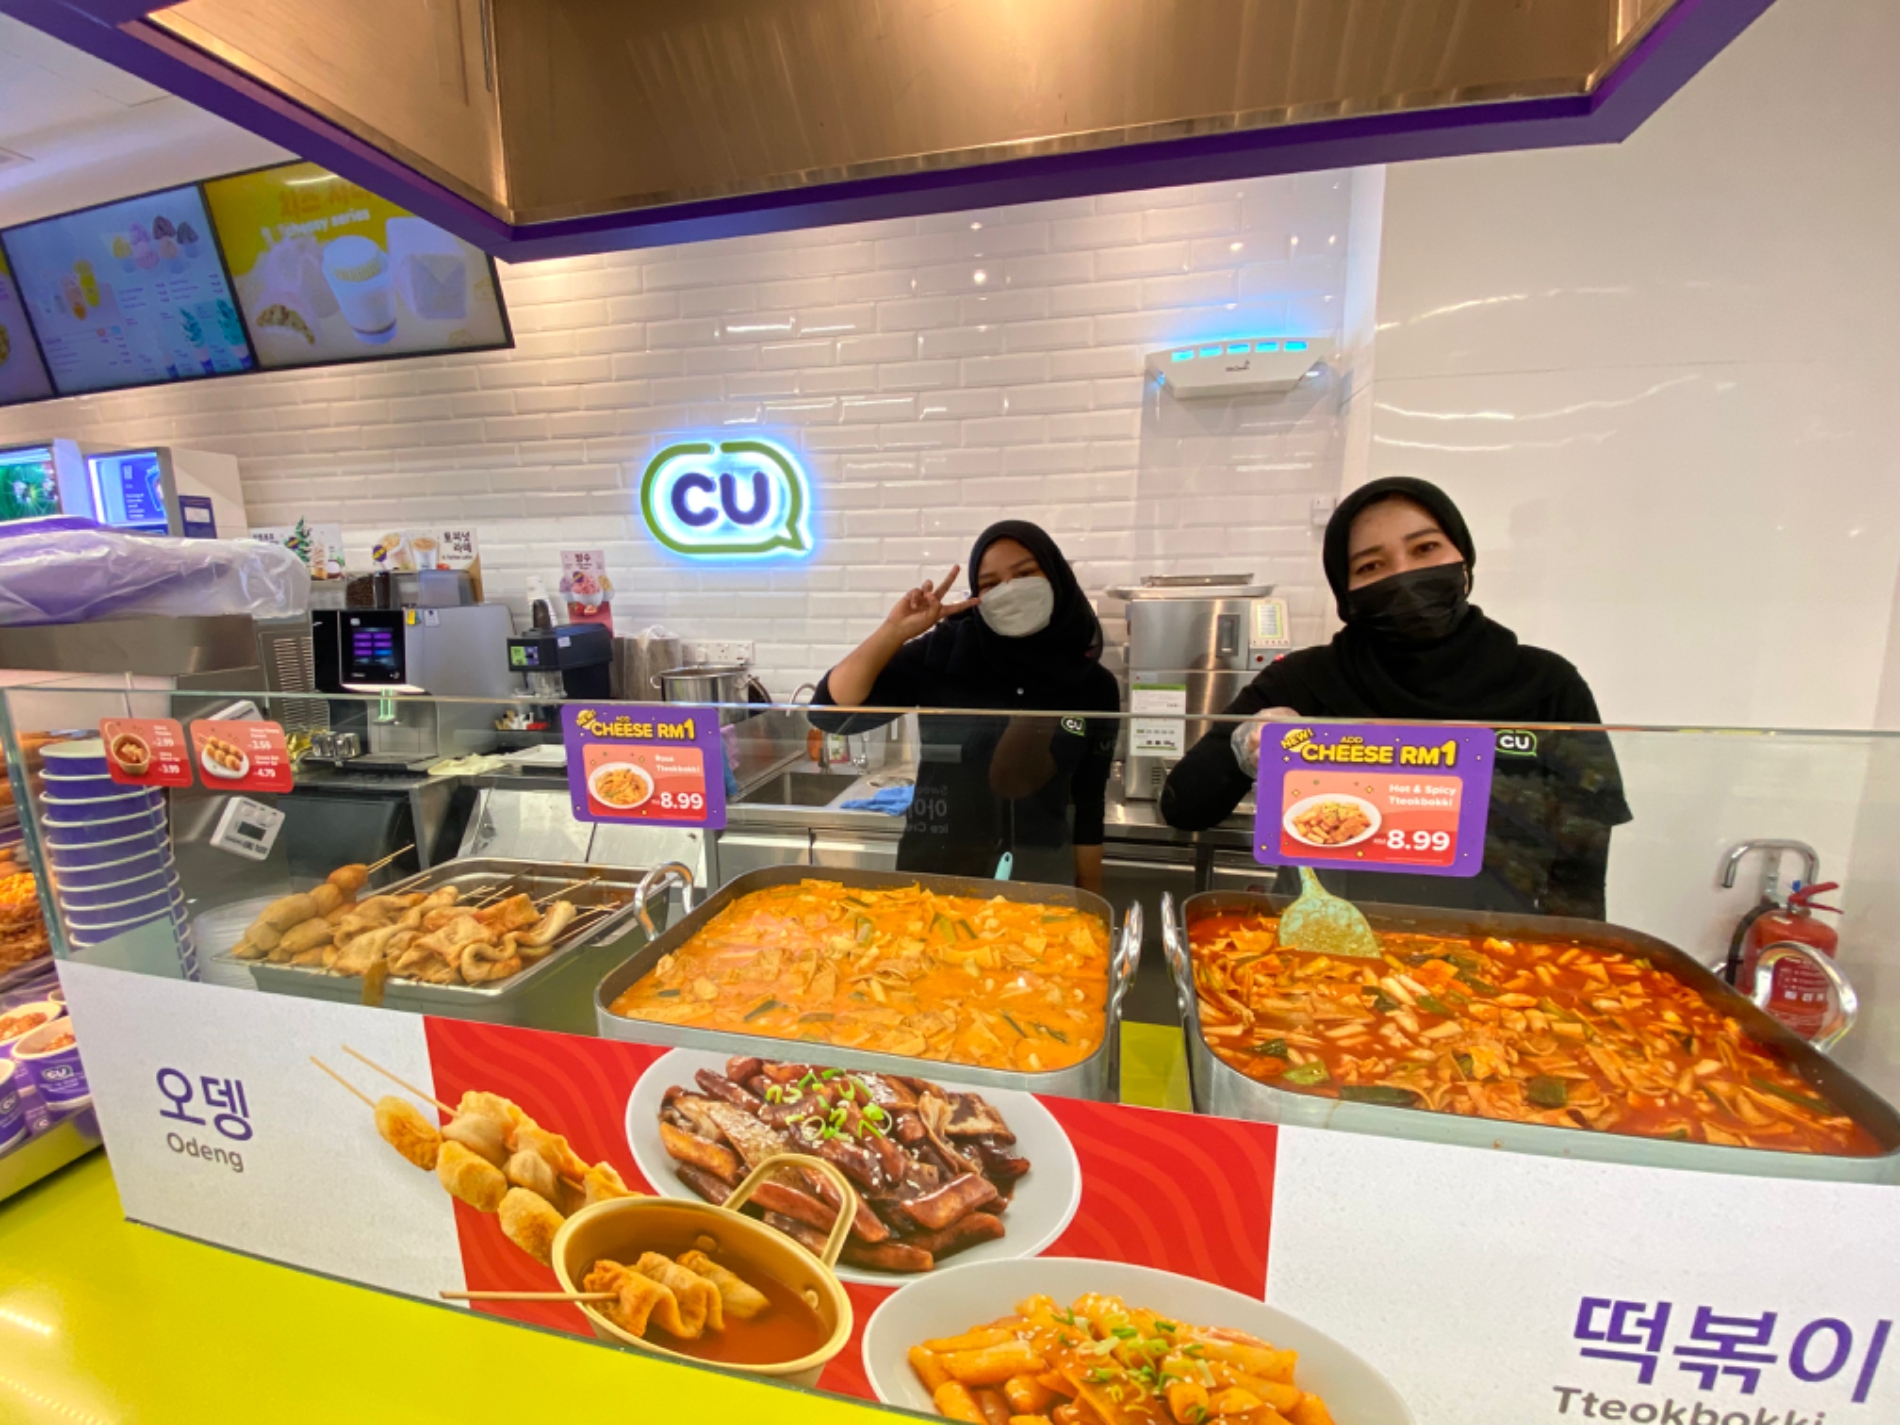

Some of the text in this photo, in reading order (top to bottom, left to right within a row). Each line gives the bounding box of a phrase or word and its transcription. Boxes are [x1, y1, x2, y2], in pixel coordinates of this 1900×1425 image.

[671, 470, 770, 527] CU
[590, 717, 696, 740] CHEESE RM1
[1066, 719, 1083, 731] CU
[1280, 727, 1315, 750] NEW!
[1340, 736, 1364, 744] ADD
[1499, 735, 1530, 750] CU
[1301, 740, 1457, 767] CHEESE RM1
[660, 791, 704, 810] 8.99
[1388, 783, 1457, 797] Hot & Spicy
[1388, 794, 1453, 807] Tteokbokki
[1387, 828, 1451, 852] 8.99
[156, 1066, 253, 1142] 오뎅
[166, 1131, 245, 1173] Odeng
[1573, 1296, 1893, 1404] 떡볶이
